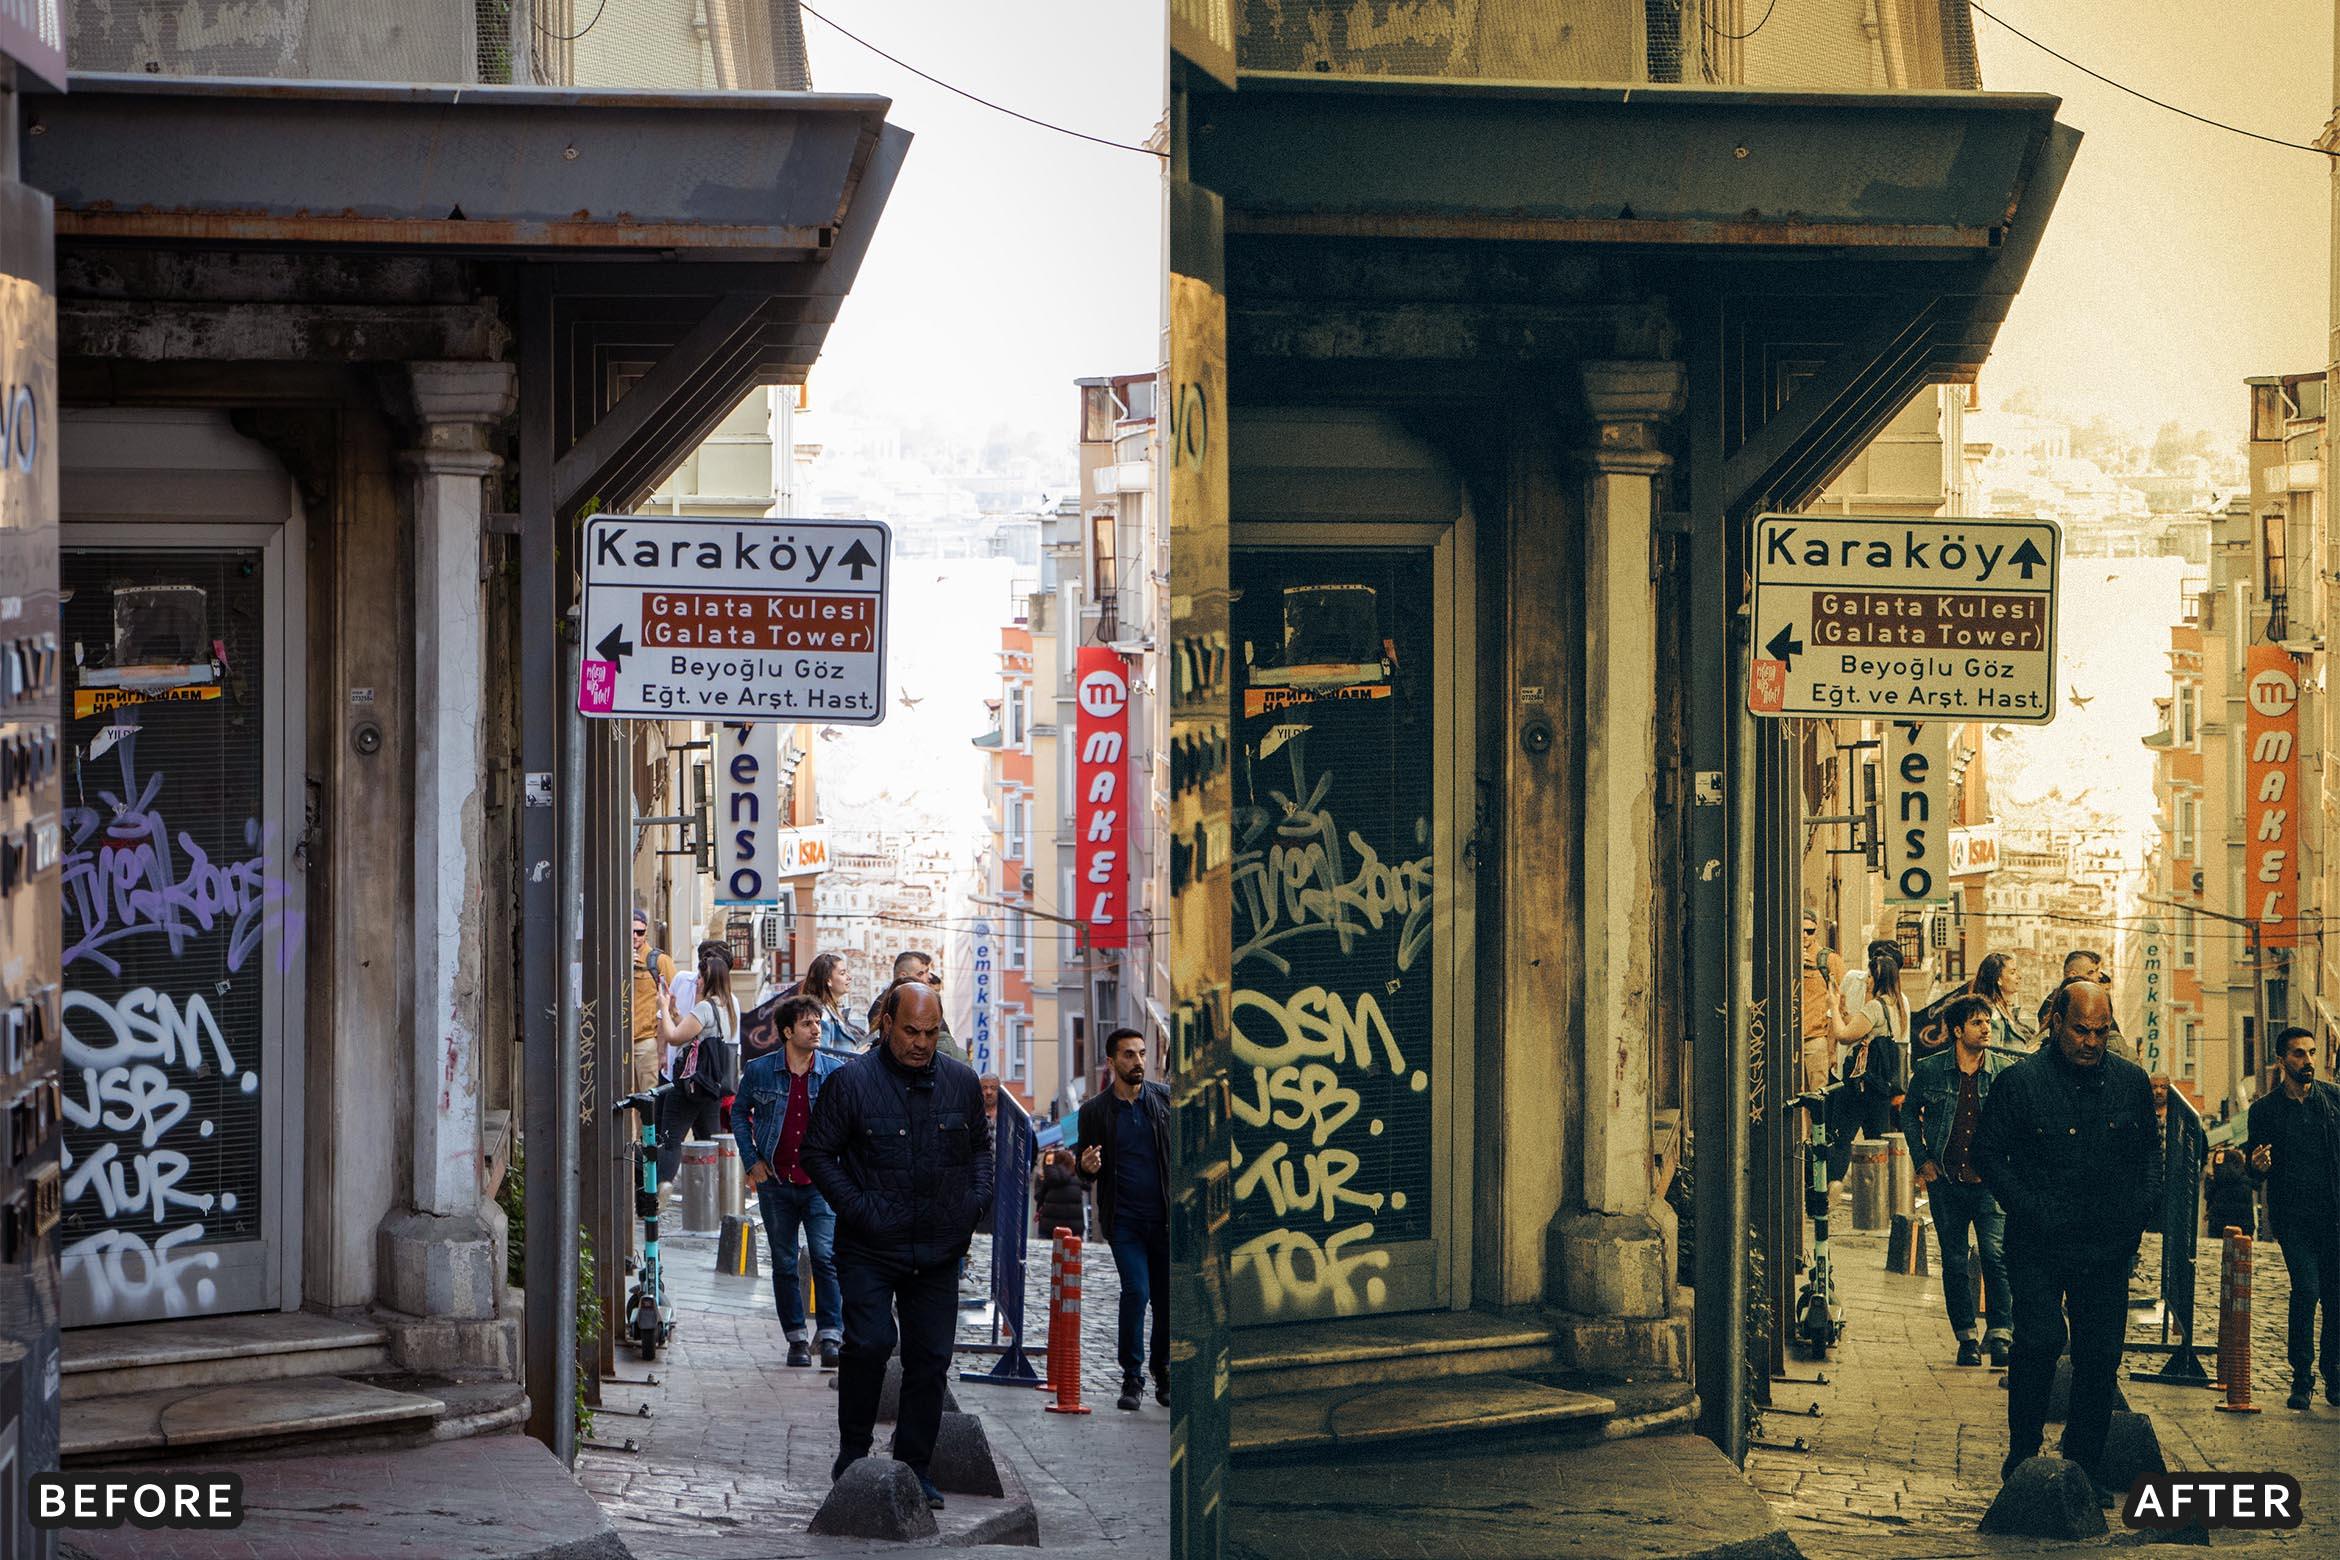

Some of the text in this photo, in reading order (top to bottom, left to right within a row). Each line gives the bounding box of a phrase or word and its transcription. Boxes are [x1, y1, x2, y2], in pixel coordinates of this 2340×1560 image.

[597, 527, 835, 583] Karaköy
[1767, 526, 2005, 582] Karaköy
[652, 595, 865, 620] Galata Kulesi
[1822, 594, 2035, 619] Galata Kulesi
[643, 620, 872, 650] (Galata Tower)
[1813, 619, 2042, 649] (Galata Tower)
[671, 656, 845, 682] Beyoğlu Göz
[1841, 655, 2015, 681] Beyoğlu Göz
[642, 684, 690, 708] Eğt.
[699, 692, 729, 706] ve
[808, 689, 873, 710] Hast.
[1812, 683, 1860, 707] Eğt.
[1869, 691, 1899, 705] ve
[1978, 688, 2043, 709] Hast.
[1082, 731, 1123, 925] MAKEL
[2252, 730, 2293, 924] MAKEL
[975, 945, 991, 1004] emek
[2145, 944, 2161, 1003] emek
